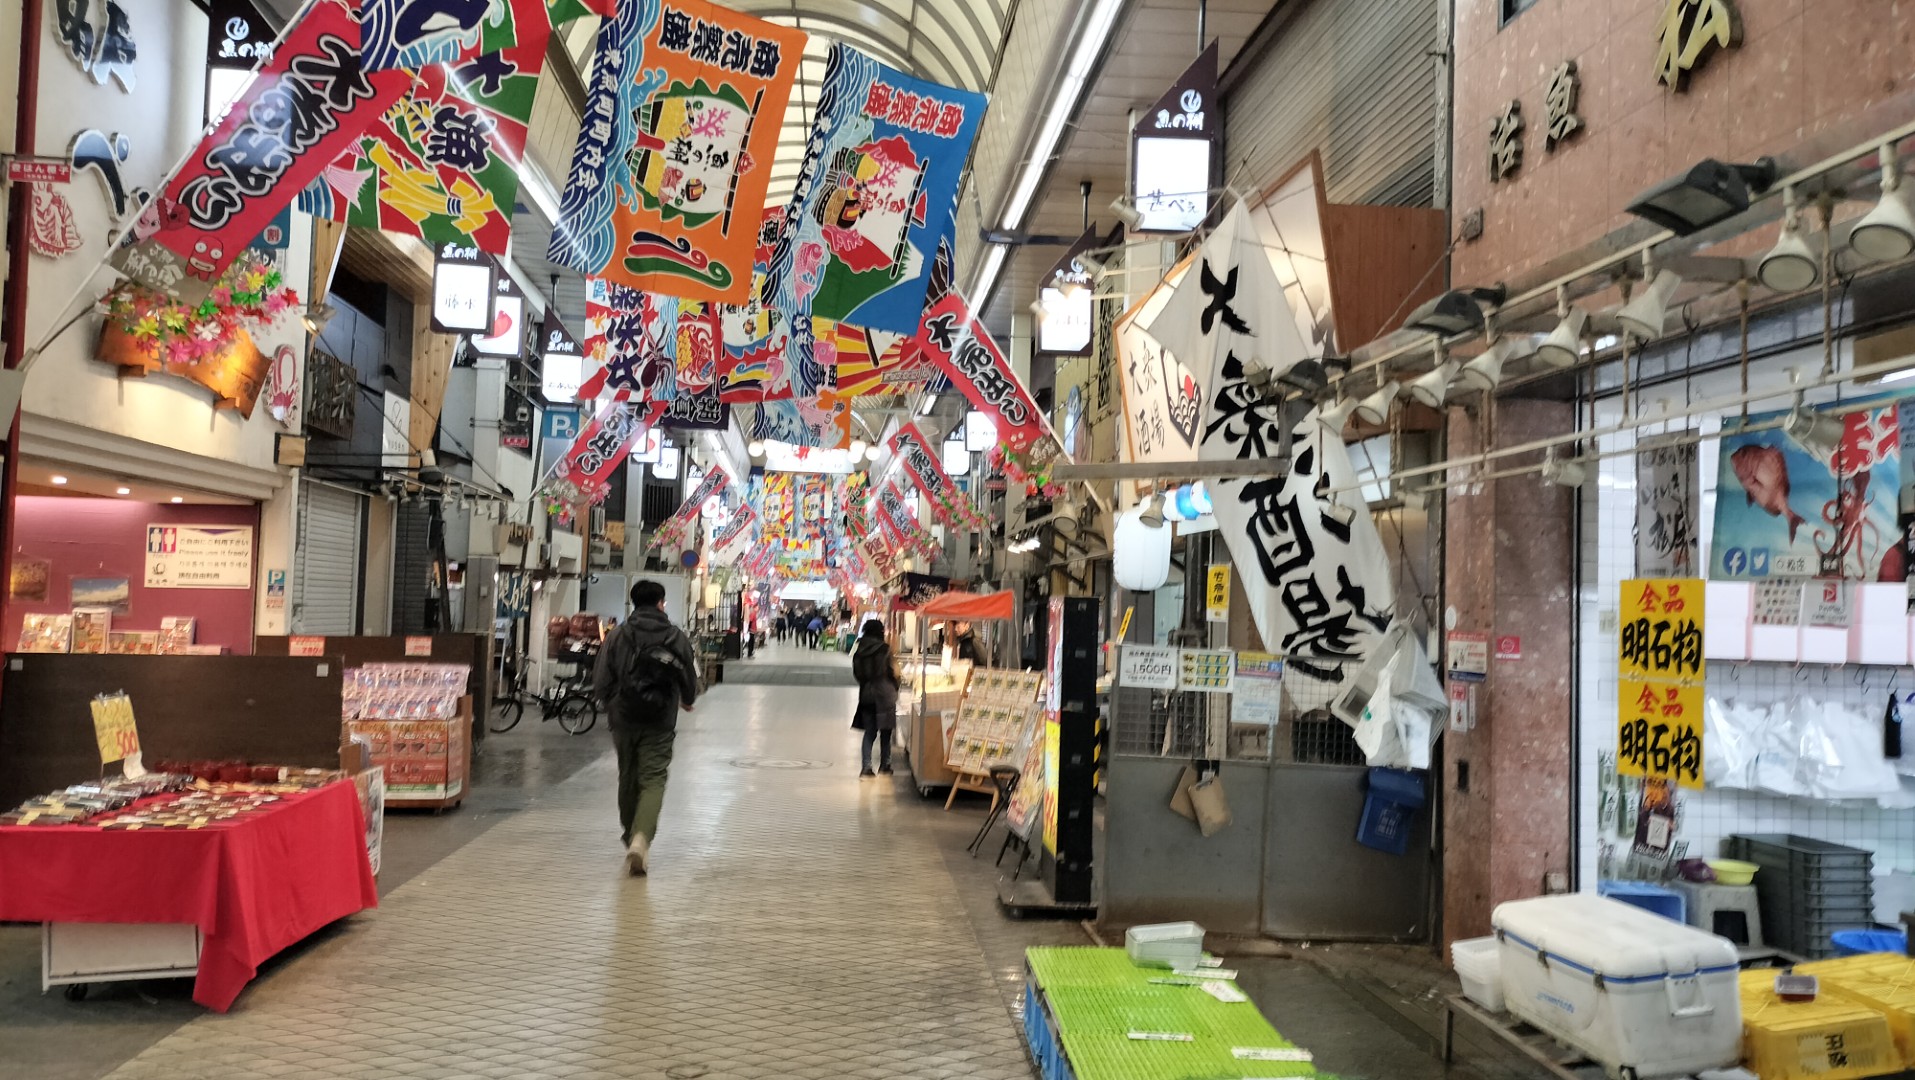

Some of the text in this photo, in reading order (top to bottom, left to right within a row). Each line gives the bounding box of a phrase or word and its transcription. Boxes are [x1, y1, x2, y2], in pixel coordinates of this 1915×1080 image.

[659, 6, 781, 79] 商売繁盛
[863, 79, 964, 139] 商売繁盛
[1155, 109, 1204, 130] 魚の棚
[925, 312, 1029, 426] 大売出し
[552, 415, 570, 437] P
[270, 571, 282, 584] P
[1213, 571, 1225, 605] 宅急便
[1637, 583, 1685, 613] 全品
[1621, 617, 1702, 674] 明石物
[1636, 684, 1684, 717] 全品
[1620, 719, 1701, 781] 明石物
